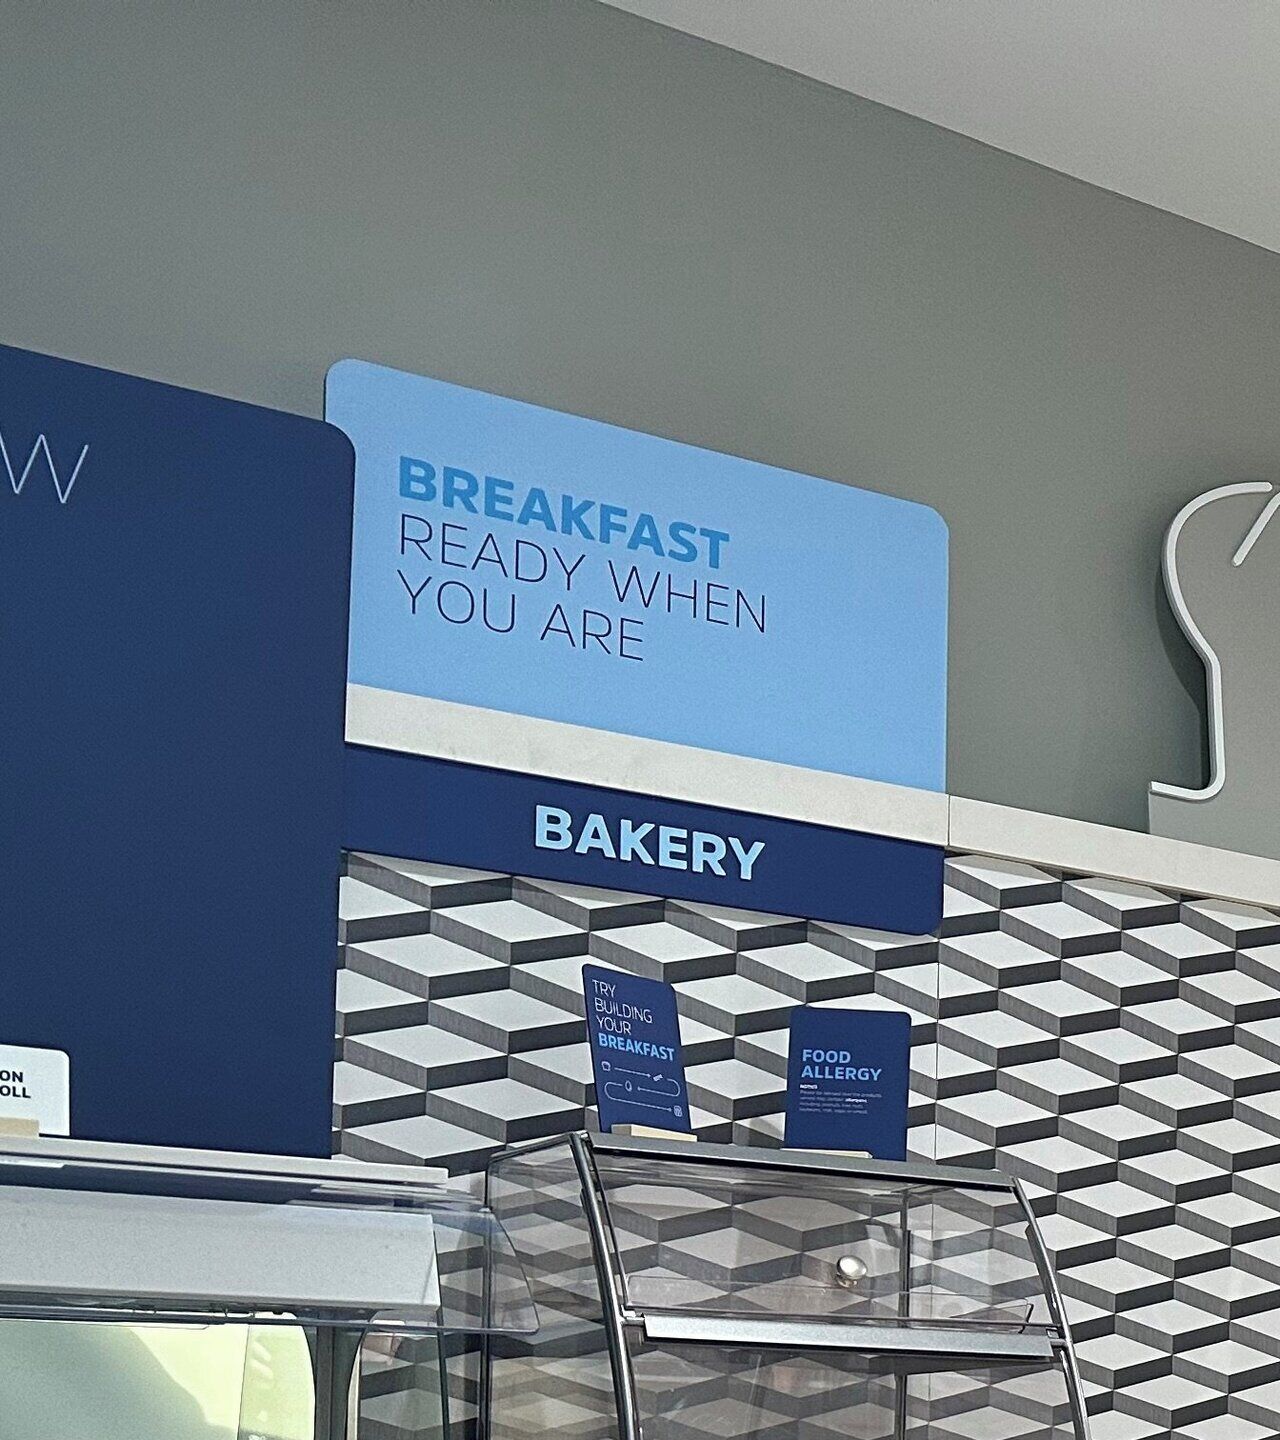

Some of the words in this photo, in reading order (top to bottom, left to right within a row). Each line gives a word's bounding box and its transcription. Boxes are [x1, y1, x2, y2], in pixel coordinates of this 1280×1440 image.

[399, 455, 730, 569] BREAKFAST
[400, 513, 586, 591] READY
[608, 559, 765, 633] WHEN
[397, 569, 516, 633] YOU
[540, 603, 643, 661] ARE
[535, 804, 766, 881] BAKERY
[592, 979, 616, 998] TRY
[594, 997, 653, 1024] BUILDING
[596, 1014, 632, 1036] YOUR
[598, 1032, 675, 1061] BREAKFAST
[802, 1048, 852, 1064] FOOD
[0, 1070, 24, 1083] ON
[801, 1064, 882, 1081] ALLERGY
